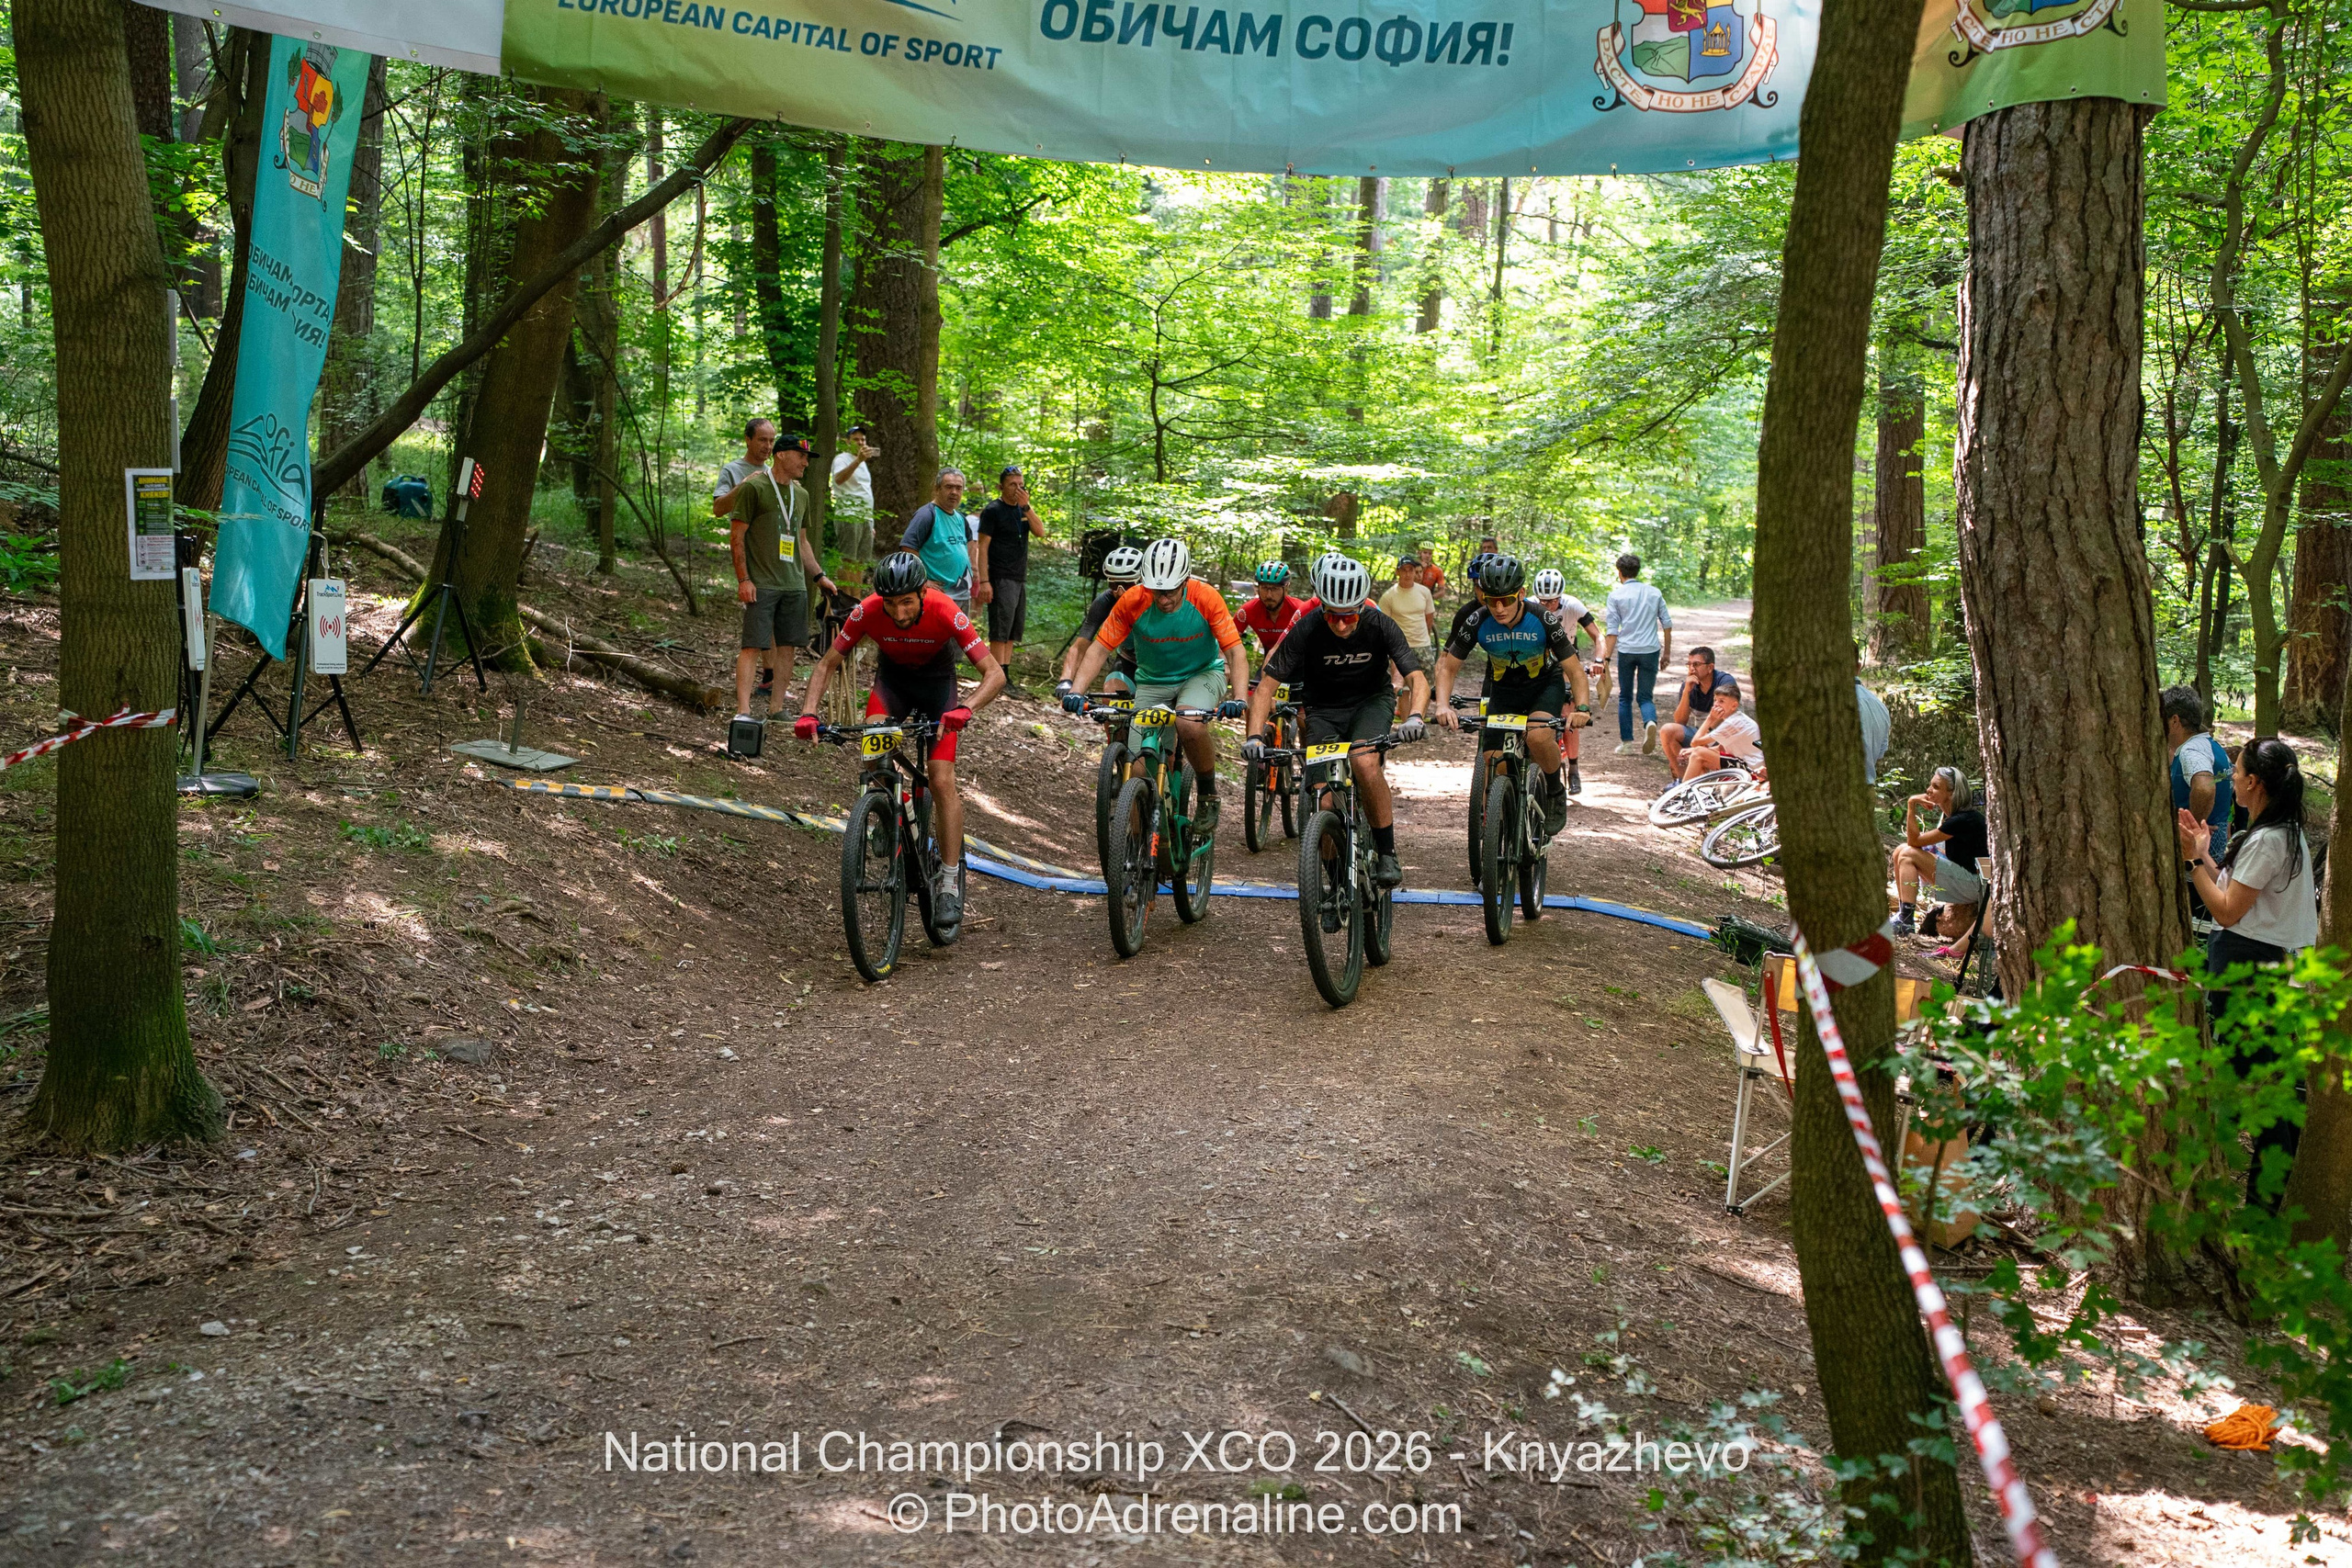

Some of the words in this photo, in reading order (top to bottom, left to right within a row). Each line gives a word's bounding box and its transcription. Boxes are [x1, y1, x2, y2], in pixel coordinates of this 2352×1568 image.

[731, 11, 852, 53] CAPITAL
[859, 31, 902, 59] OF
[904, 38, 1002, 71] SPORT
[1039, 0, 1283, 57] ОБИЧАМ
[1295, 15, 1514, 67] СОФИЯ!
[2001, 29, 2028, 44] НО
[2035, 24, 2069, 39] НЕ
[1600, 37, 1644, 103] РАСТЕ
[1657, 95, 1684, 108] НО
[1690, 94, 1720, 108] НЕ
[299, 180, 317, 194] НЕ
[246, 269, 291, 312] БИЧАМ
[1486, 631, 1538, 643] SIEMENS
[1140, 709, 1171, 725] 101
[1497, 715, 1520, 723] 97
[869, 735, 894, 752] 98
[1315, 744, 1340, 755] 99
